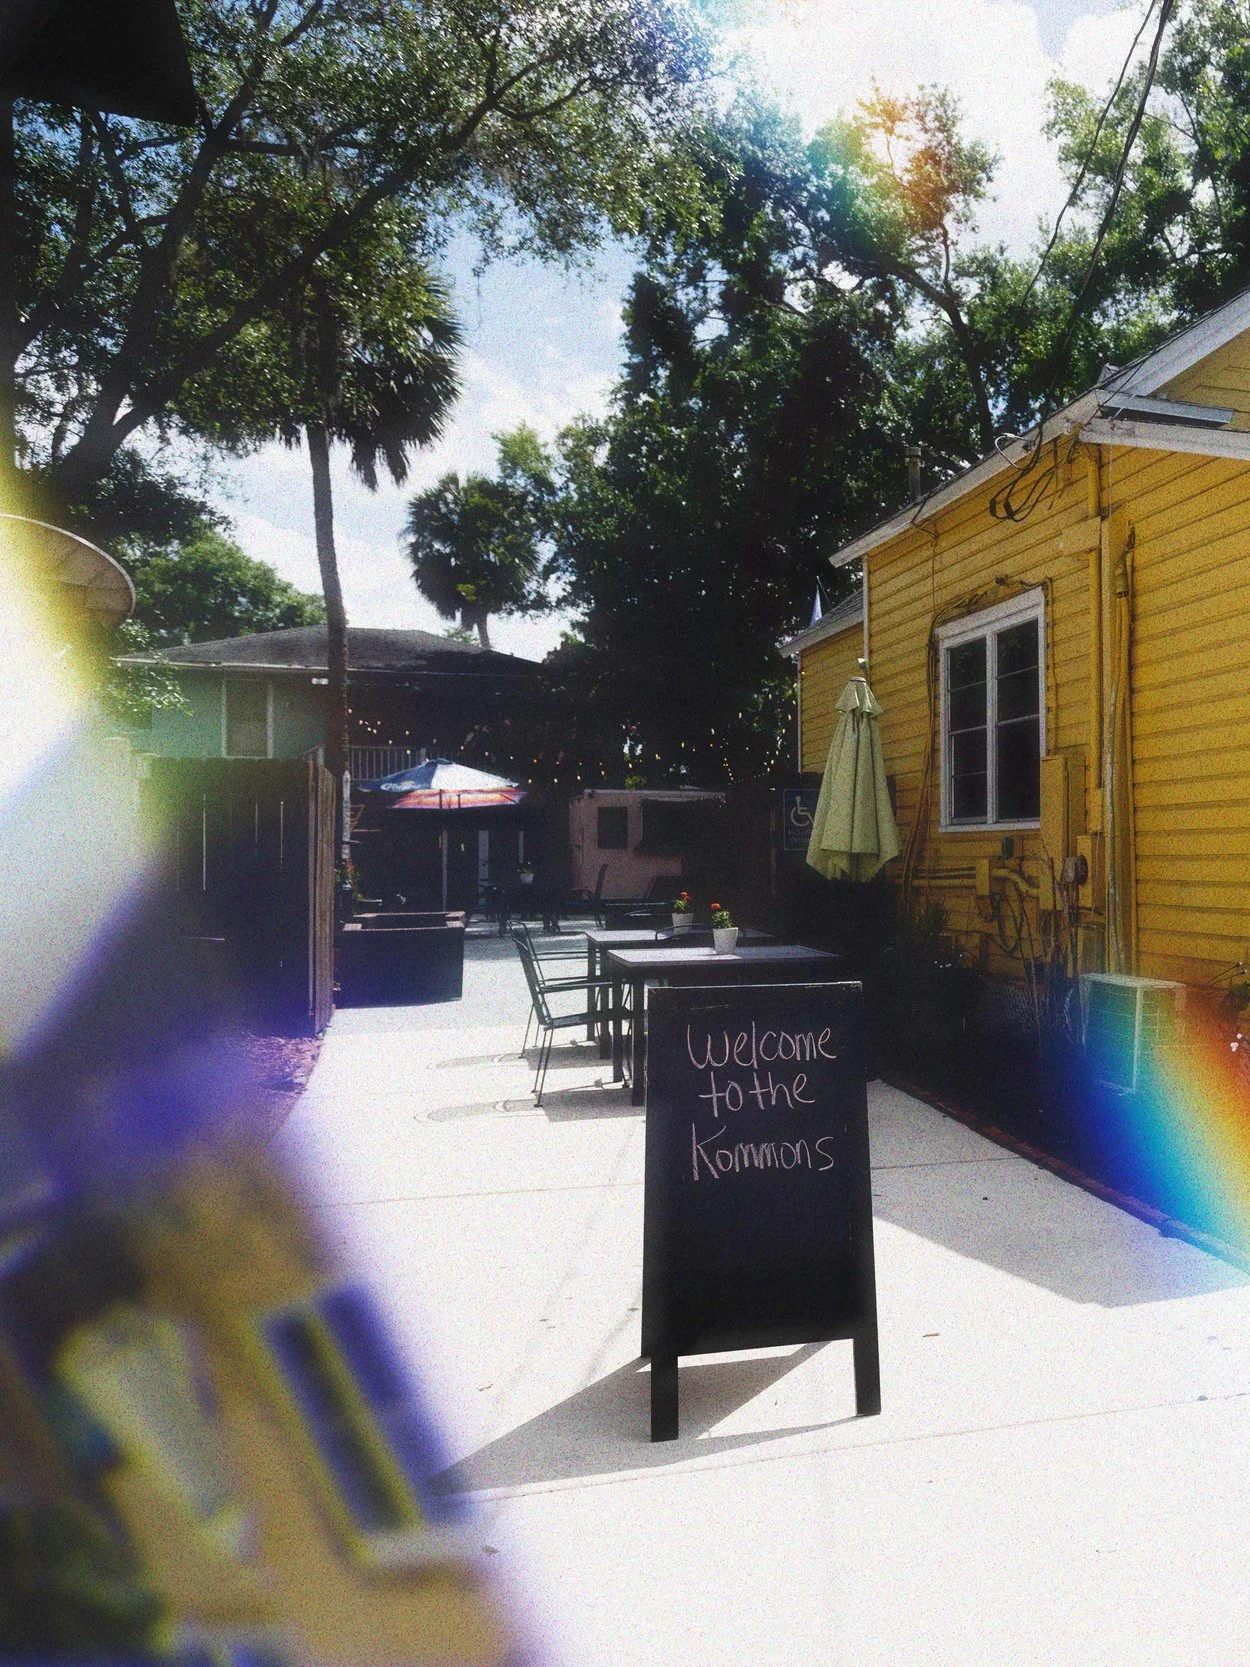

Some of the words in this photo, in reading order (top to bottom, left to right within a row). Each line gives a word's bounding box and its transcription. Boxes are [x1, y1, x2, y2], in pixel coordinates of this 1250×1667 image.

[686, 1020, 837, 1069] Welcome
[698, 1070, 744, 1118] to
[748, 1070, 816, 1110] the
[691, 1122, 835, 1181] Kommons
